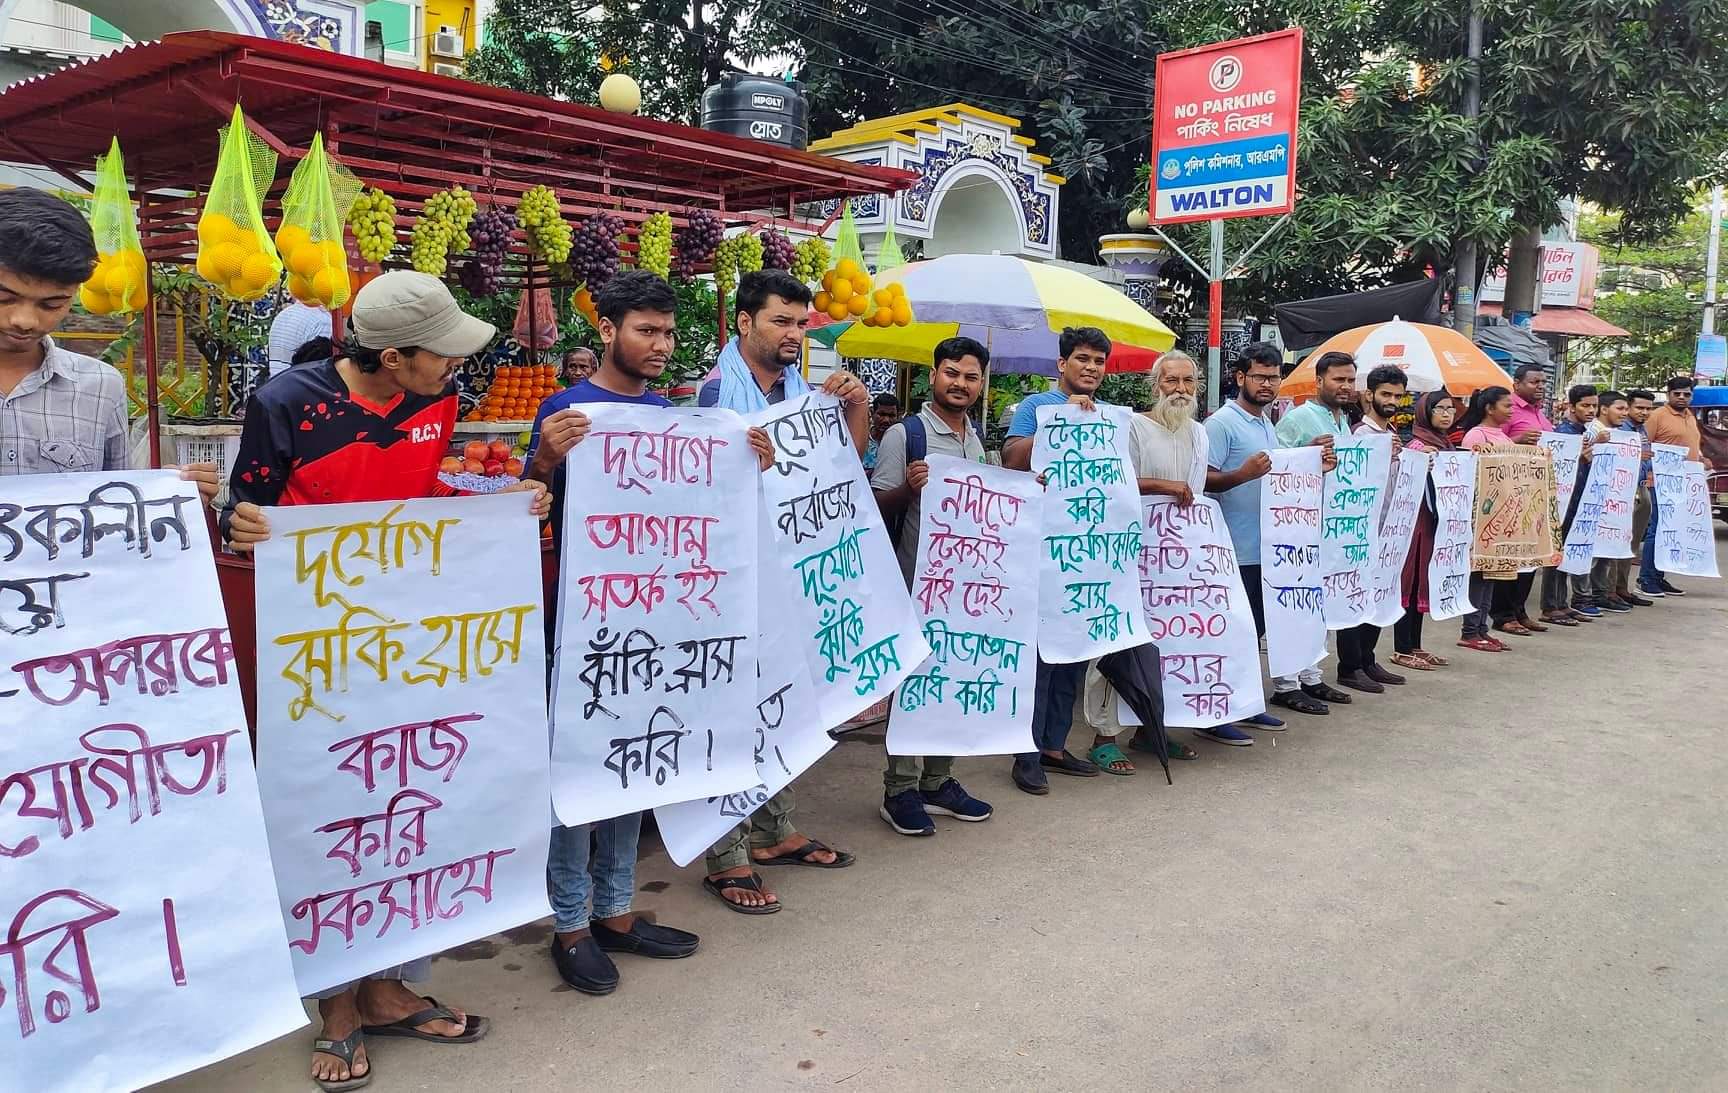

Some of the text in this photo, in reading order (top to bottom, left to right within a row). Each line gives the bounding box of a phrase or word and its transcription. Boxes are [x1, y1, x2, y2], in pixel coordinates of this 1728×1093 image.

[1174, 90, 1277, 119] NO PARKING
[1176, 112, 1274, 140] পার্কিং নিষেধ
[1183, 155, 1205, 177] পুলিশ
[1171, 184, 1273, 211] WALTON
[411, 421, 442, 444] R.C.Y
[1044, 410, 1118, 455] টেকসই
[941, 474, 1026, 531] নদীতে
[1063, 487, 1112, 525] করি
[928, 513, 1009, 574] টেকসই
[578, 559, 728, 623] সতর্ক হই
[917, 568, 955, 615] বাঁধ
[1063, 581, 1112, 615] হ্রাস
[1086, 603, 1122, 642] করি
[579, 627, 665, 720] ঝুঁকি
[665, 636, 747, 692] হ্রাস
[955, 668, 1004, 716] করি
[1183, 682, 1234, 720] করি
[328, 713, 484, 792] কাজ
[604, 706, 691, 788] করি
[313, 788, 444, 877] করি
[289, 848, 516, 954] একসাথে
